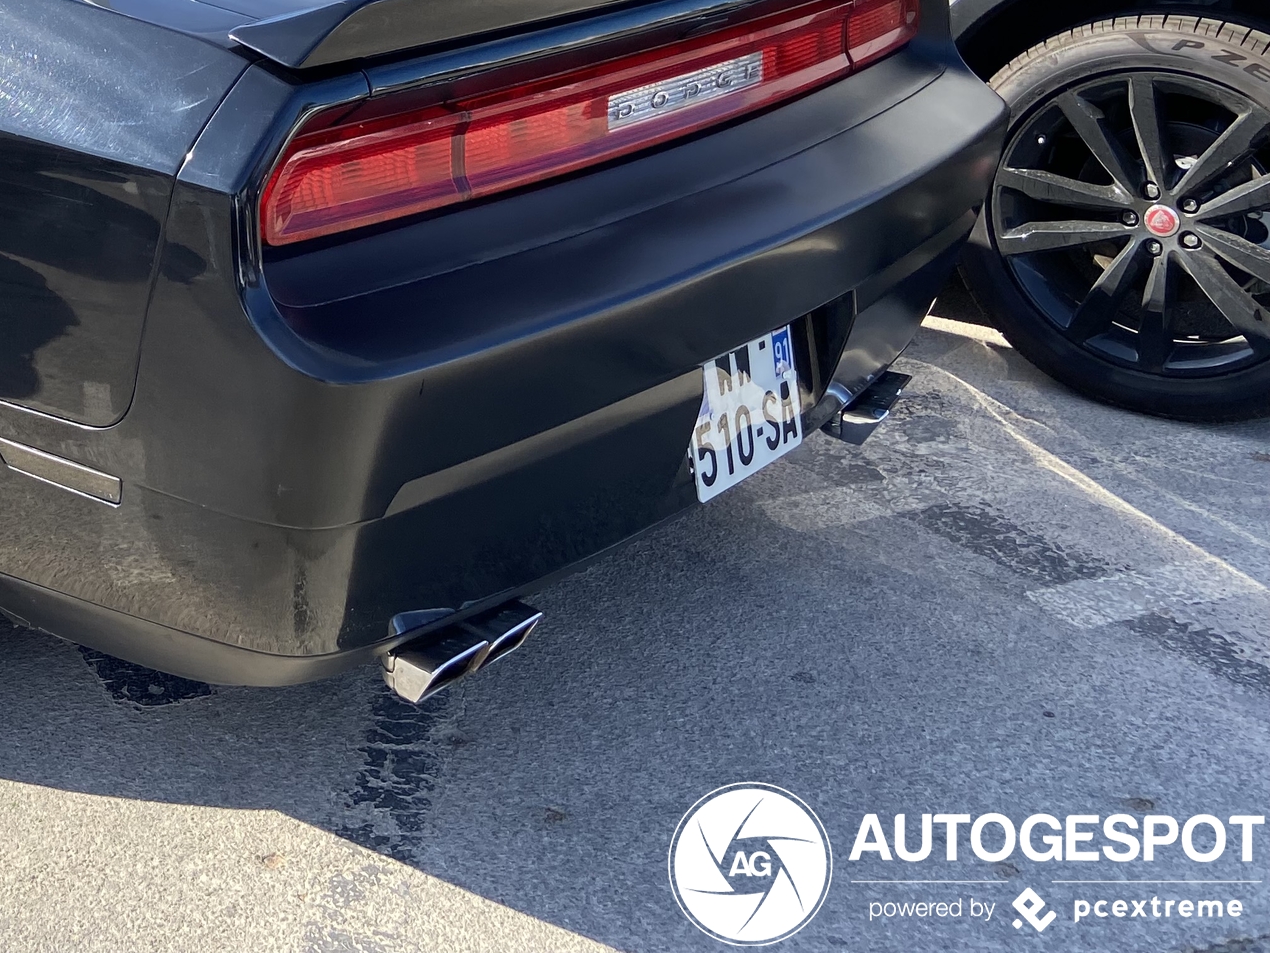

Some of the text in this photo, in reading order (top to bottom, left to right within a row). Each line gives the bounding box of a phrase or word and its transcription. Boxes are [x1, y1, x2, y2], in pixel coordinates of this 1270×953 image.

[1171, 39, 1205, 51] P
[614, 64, 761, 120] DODGE
[696, 380, 798, 487] 510-SA
